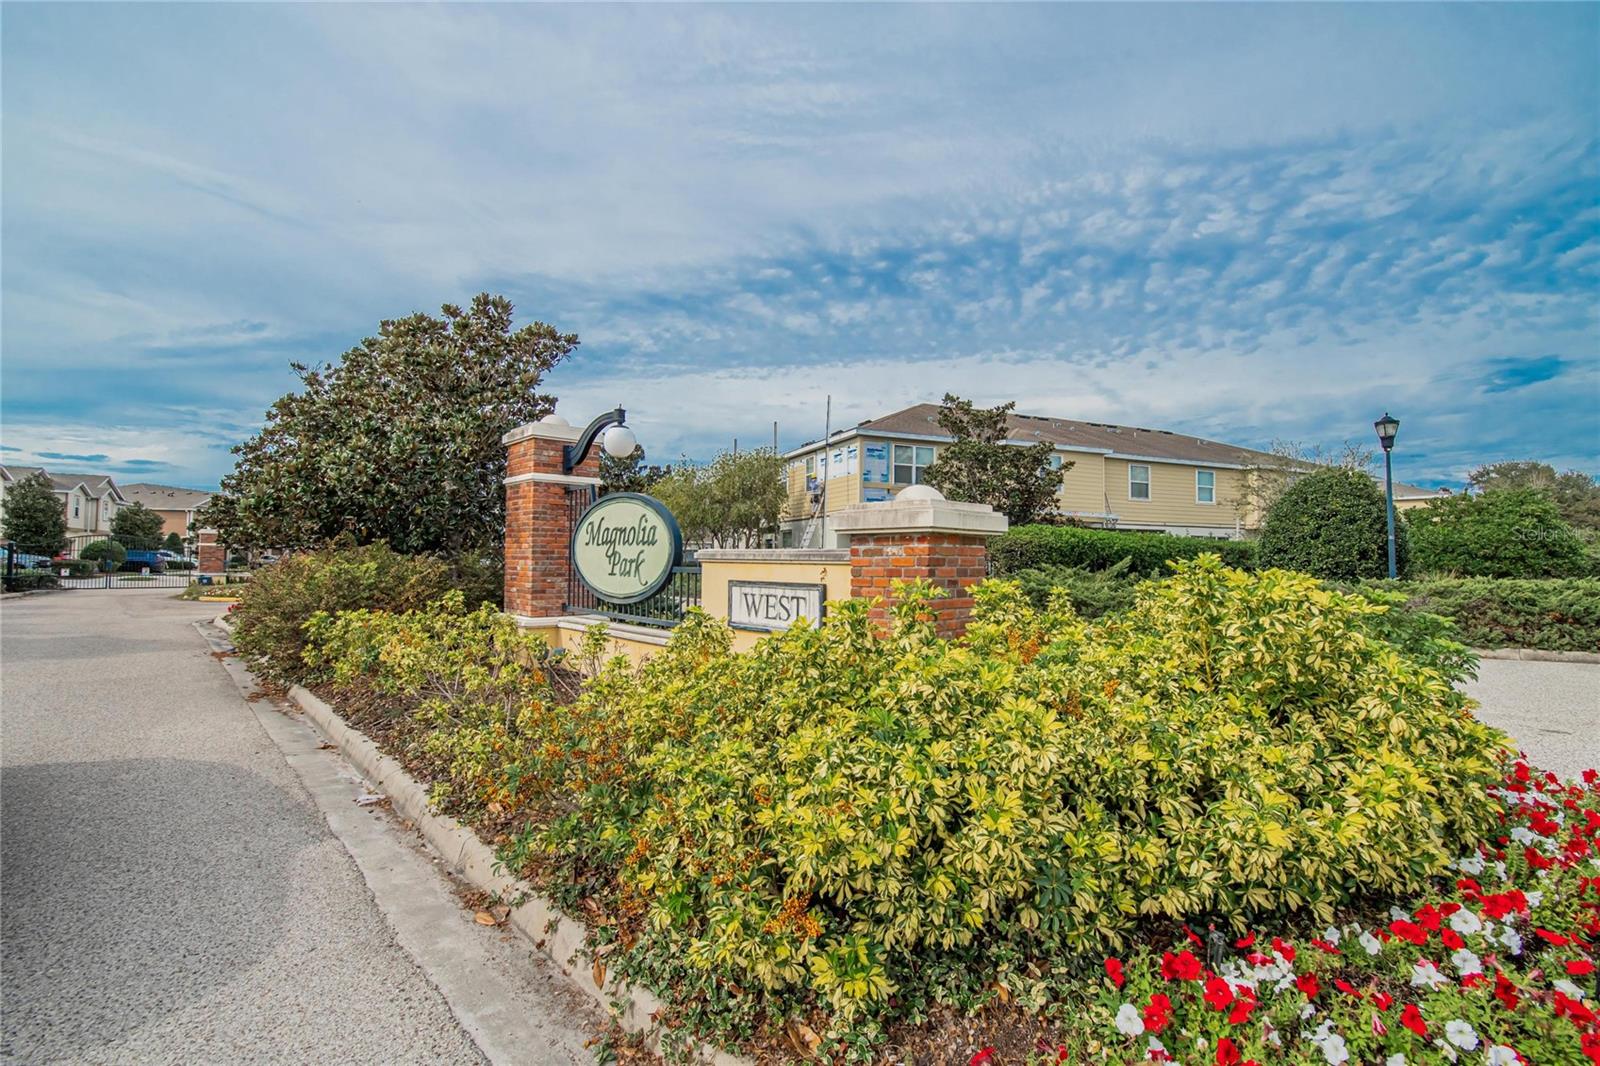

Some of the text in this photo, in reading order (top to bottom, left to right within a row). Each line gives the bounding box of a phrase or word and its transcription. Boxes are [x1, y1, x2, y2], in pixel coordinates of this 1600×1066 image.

[585, 514, 657, 558] Magnolia
[608, 550, 648, 586] Park
[743, 592, 807, 622] WEST
